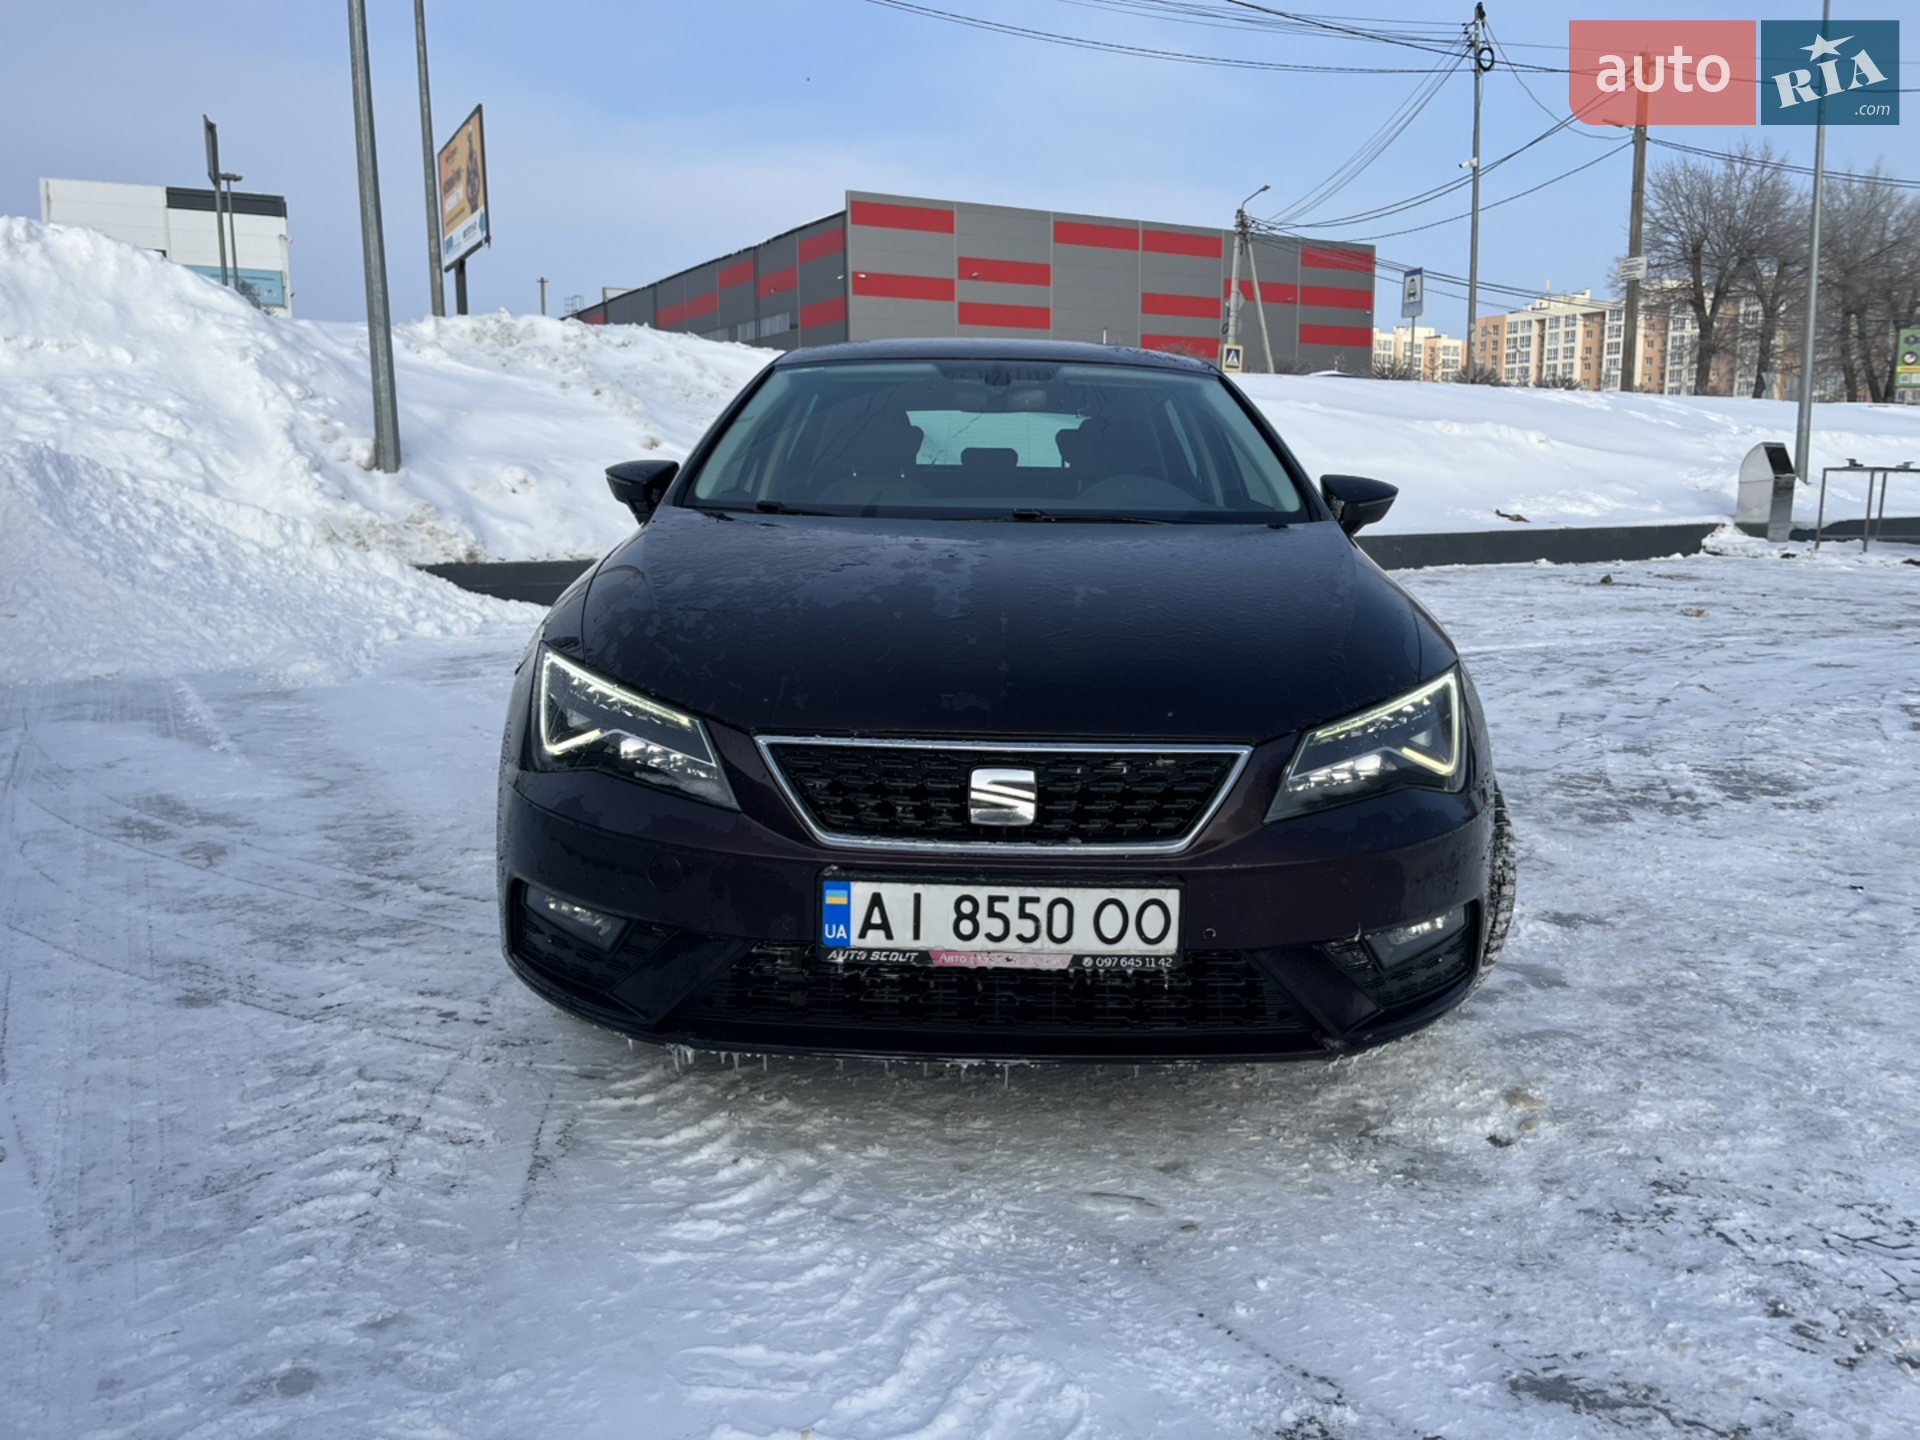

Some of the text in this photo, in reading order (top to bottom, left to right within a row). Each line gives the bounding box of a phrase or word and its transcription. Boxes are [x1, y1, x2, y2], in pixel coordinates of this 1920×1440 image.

[857, 891, 1172, 945] AI 8550 OO
[824, 924, 847, 940] UA
[827, 950, 919, 962] AUTO SCOUT
[1095, 956, 1173, 968] 097 645 11 42
